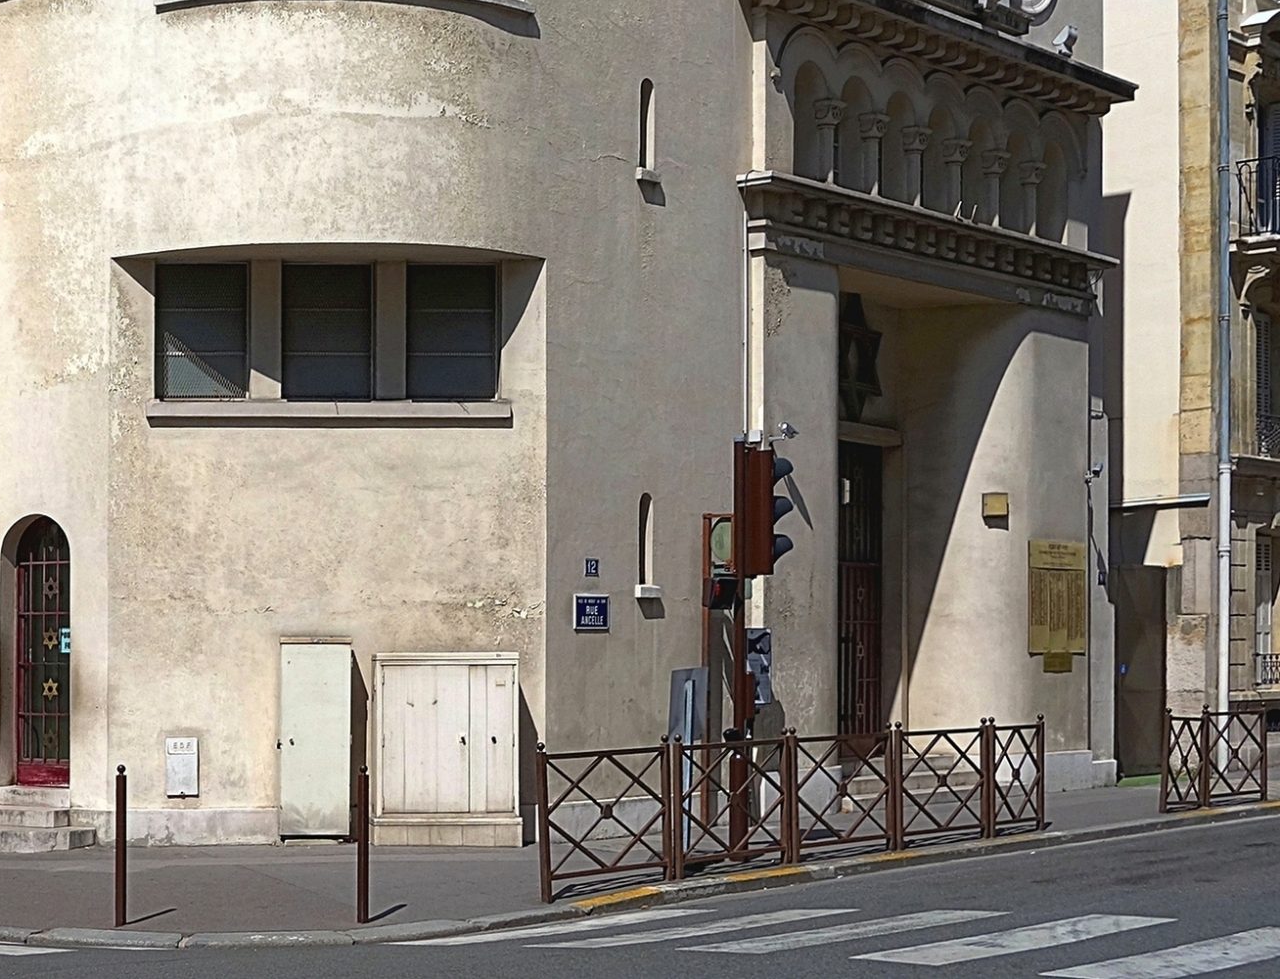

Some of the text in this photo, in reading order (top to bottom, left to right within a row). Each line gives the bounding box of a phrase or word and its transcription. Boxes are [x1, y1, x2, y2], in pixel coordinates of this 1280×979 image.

[587, 560, 597, 573] 12
[586, 605, 598, 615] RUE
[580, 616, 604, 625] ANCELLE
